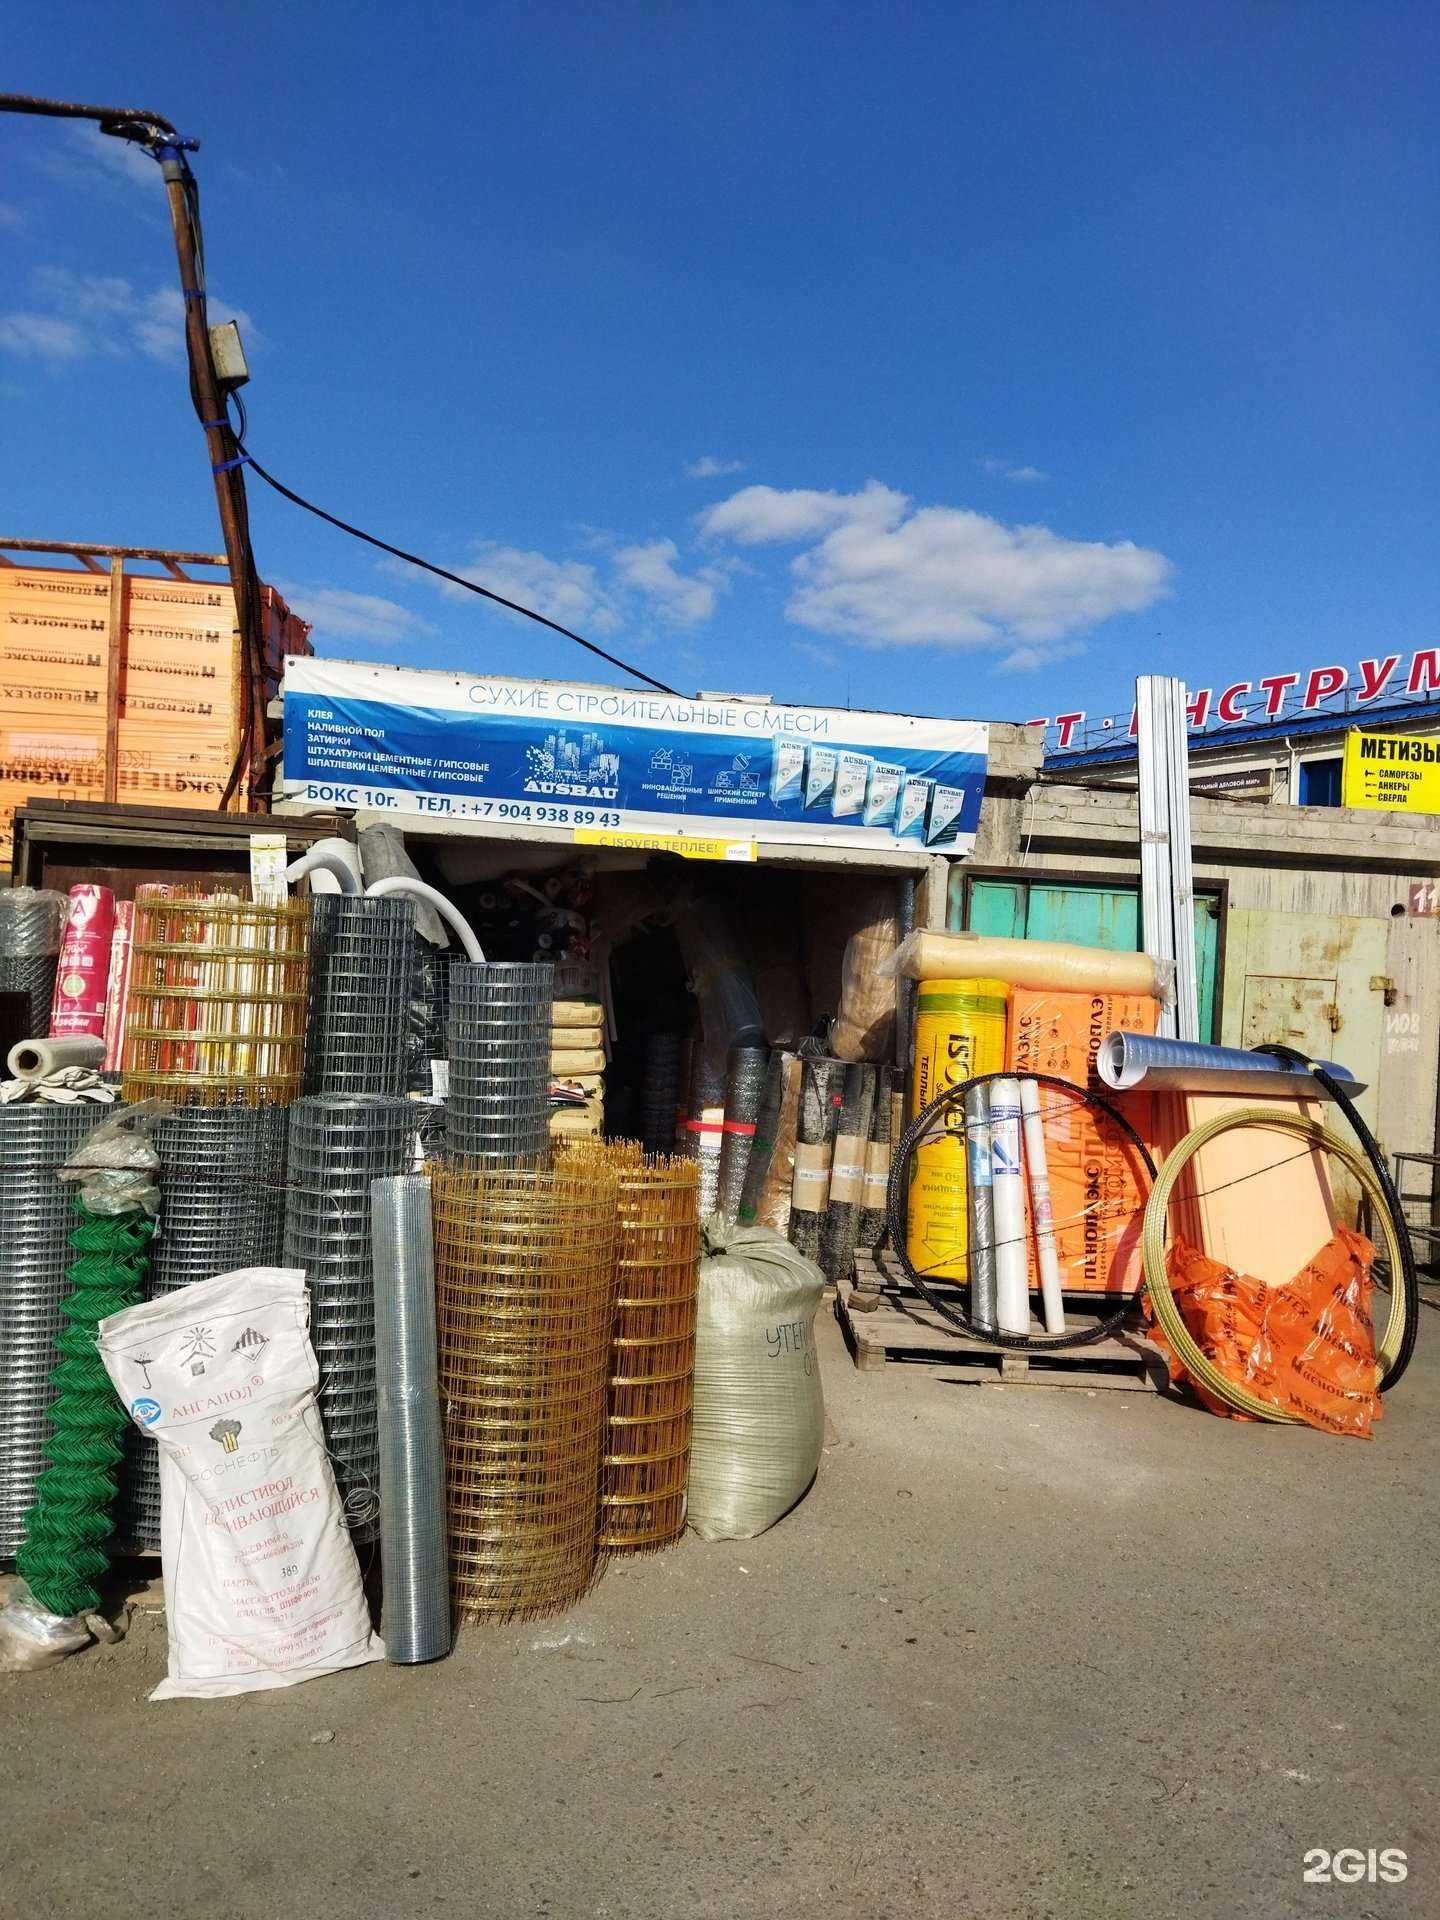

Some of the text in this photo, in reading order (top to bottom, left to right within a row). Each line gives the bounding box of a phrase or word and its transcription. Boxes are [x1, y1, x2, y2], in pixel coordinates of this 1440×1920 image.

[307, 709, 333, 720] КЛЕЯ
[468, 684, 830, 734] СУХИЕ СТРОИТЕЛЬНЫЕ СМЕСИ
[307, 722, 385, 738] НАЛИВНОЙ ПОЛ
[307, 734, 351, 746] ЗАТИРКИ
[307, 746, 372, 760] ШТУКАТУРКИ
[373, 753, 432, 766] ЦЕМЕНТНЫЕ
[439, 759, 490, 772] ГИПСОВЫЕ
[307, 758, 366, 771] ШПАТЛЕВКИ
[367, 764, 426, 778] ЦЕМЕНТНЫЕ
[432, 770, 484, 783] ГИПСОВЫЕ
[1379, 769, 1422, 780] САМОРЕЗЫ
[523, 780, 619, 799] AUSBAU
[1378, 781, 1410, 791] АНКЕРЫ
[656, 793, 687, 801] РЕШЕНИЯ
[708, 788, 766, 799] ШИРОКИЙ СПЕКТР
[1377, 793, 1407, 803] СВЕРЛА
[307, 785, 359, 804] БОКС
[416, 795, 456, 814] ТЕЛ.
[471, 803, 493, 816] +7
[499, 804, 531, 819] 904
[536, 808, 569, 823] 938
[575, 810, 595, 825] 89
[599, 812, 621, 827] 43
[714, 796, 758, 805] ПРИМЕНЕНИЙ
[612, 837, 660, 851] ISOVER
